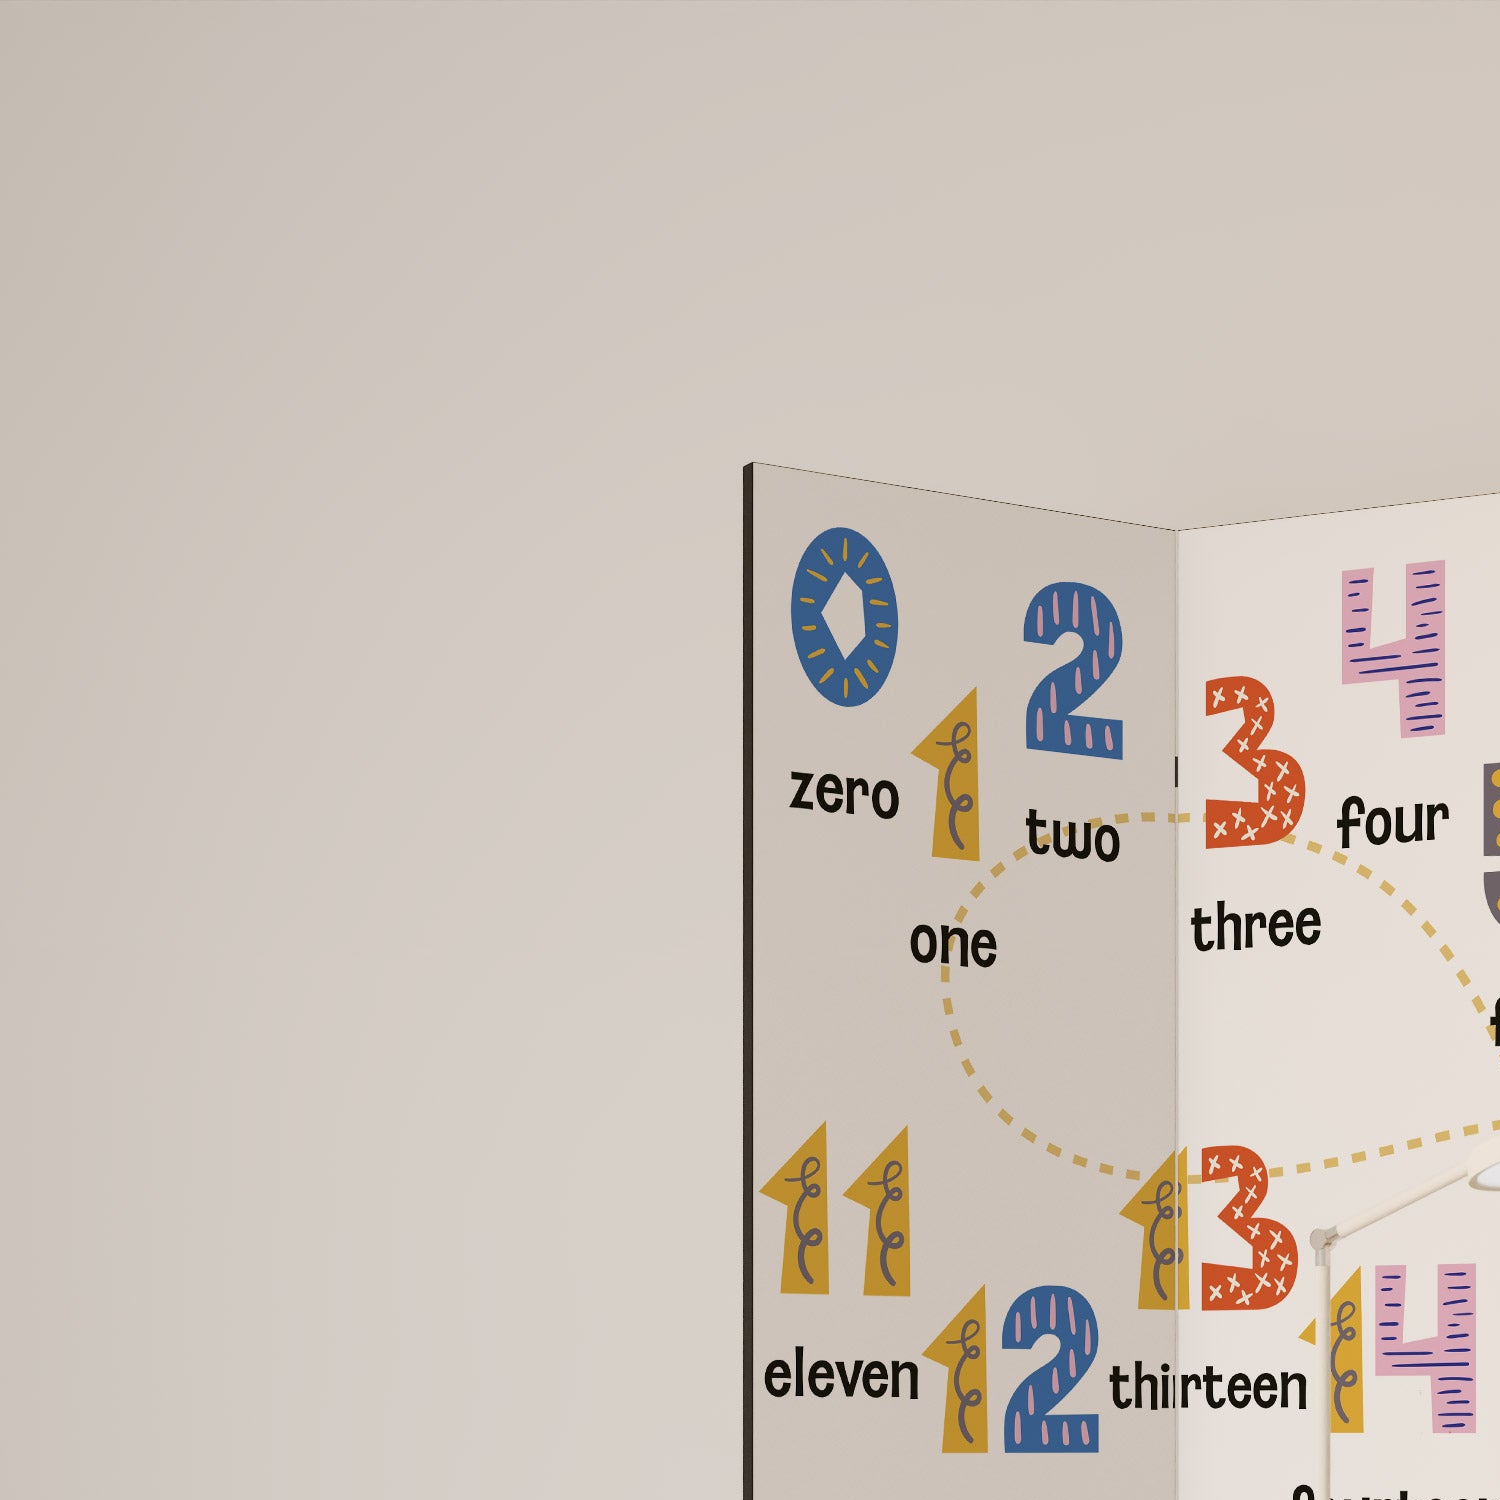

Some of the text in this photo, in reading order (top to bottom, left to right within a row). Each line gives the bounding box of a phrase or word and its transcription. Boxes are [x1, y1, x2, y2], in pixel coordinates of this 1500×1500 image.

[1023, 581, 1123, 760] 2
[1342, 560, 1445, 738] 4
[790, 771, 899, 819] zero
[911, 686, 980, 861] 1
[1026, 809, 1119, 862] two
[1206, 675, 1305, 849] 3
[1337, 796, 1449, 848] four
[911, 924, 997, 967] one
[1191, 901, 1321, 951] three
[758, 1121, 911, 1296] 11
[1119, 1145, 1298, 1311] 13
[765, 1346, 919, 1399] eleven
[921, 1284, 1099, 1453] 12
[1109, 1361, 1306, 1410] thirteen
[1298, 1263, 1476, 1433] 14
